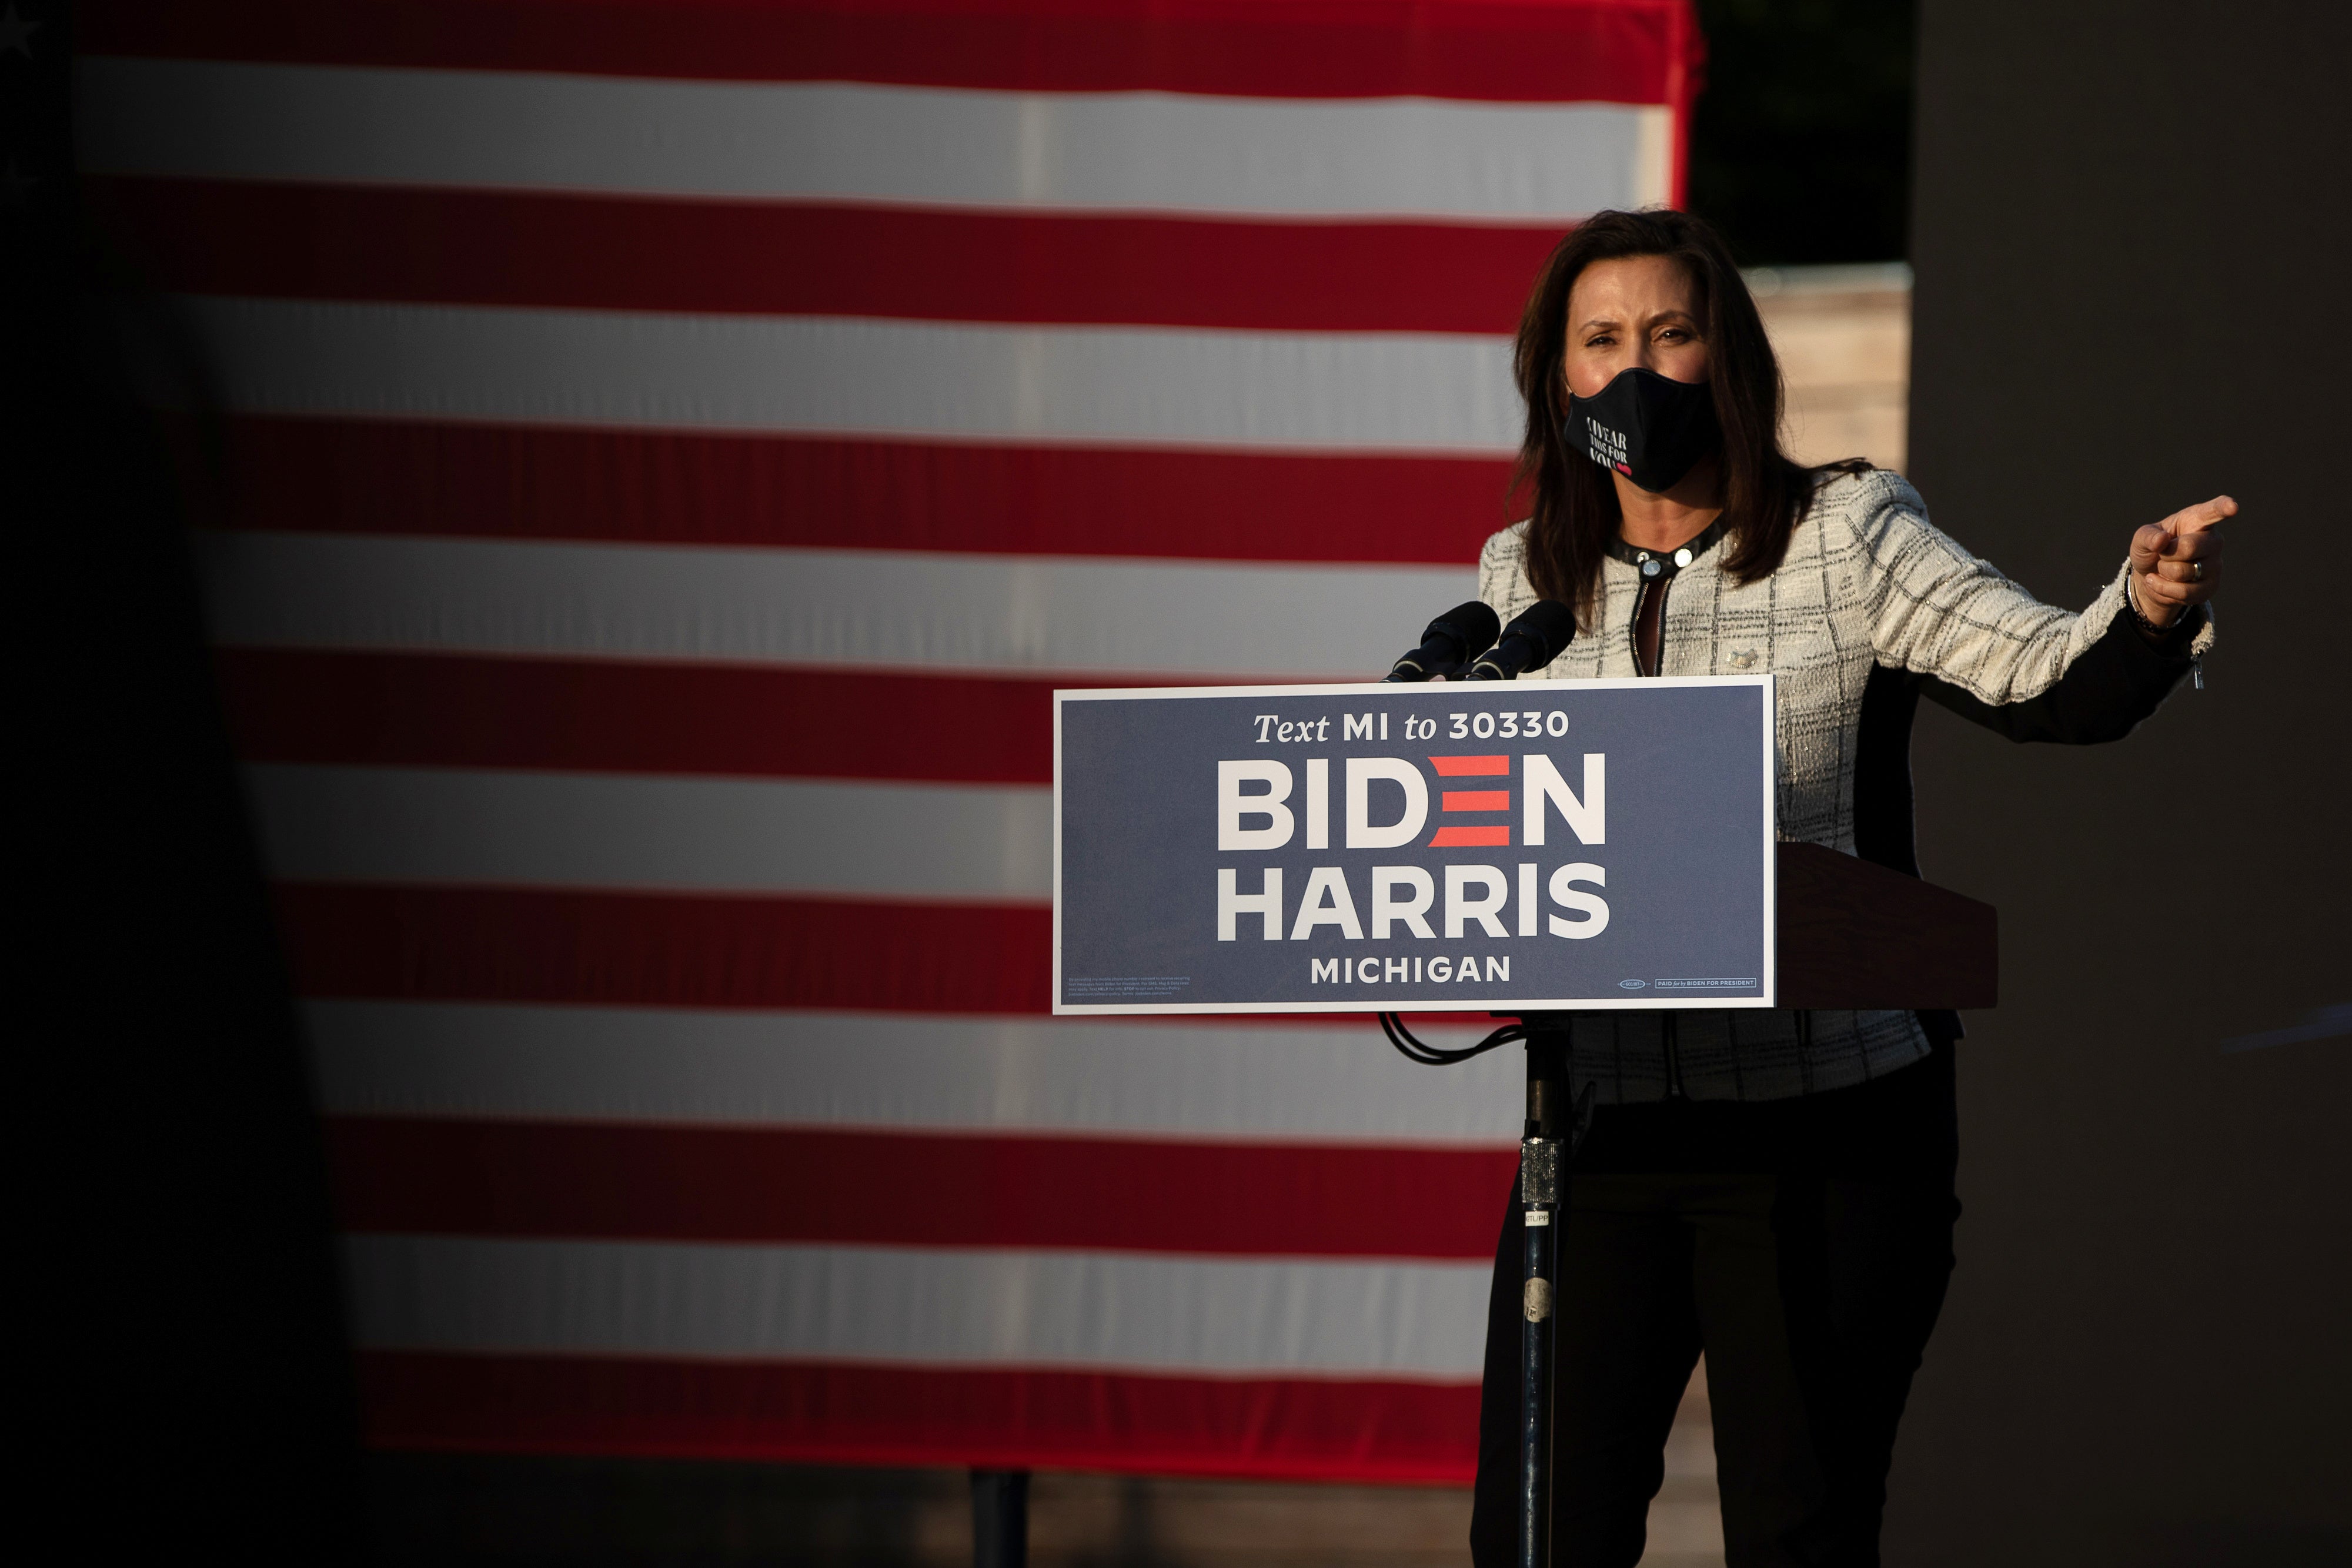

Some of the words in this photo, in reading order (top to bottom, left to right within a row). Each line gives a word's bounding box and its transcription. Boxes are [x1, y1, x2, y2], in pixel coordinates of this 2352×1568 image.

[1589, 433, 1607, 454] THIS
[1608, 445, 1628, 464] FOR
[1592, 419, 1627, 450] WEAR
[1590, 447, 1618, 470] YOU
[1254, 715, 1330, 743] Text
[1344, 713, 1388, 741] MI
[1405, 714, 1436, 741] to
[1449, 711, 1569, 739] 30330
[1218, 753, 1605, 851] BIDEN
[1217, 862, 1610, 941] HARRIS
[1311, 955, 1509, 984] MICHIGAN
